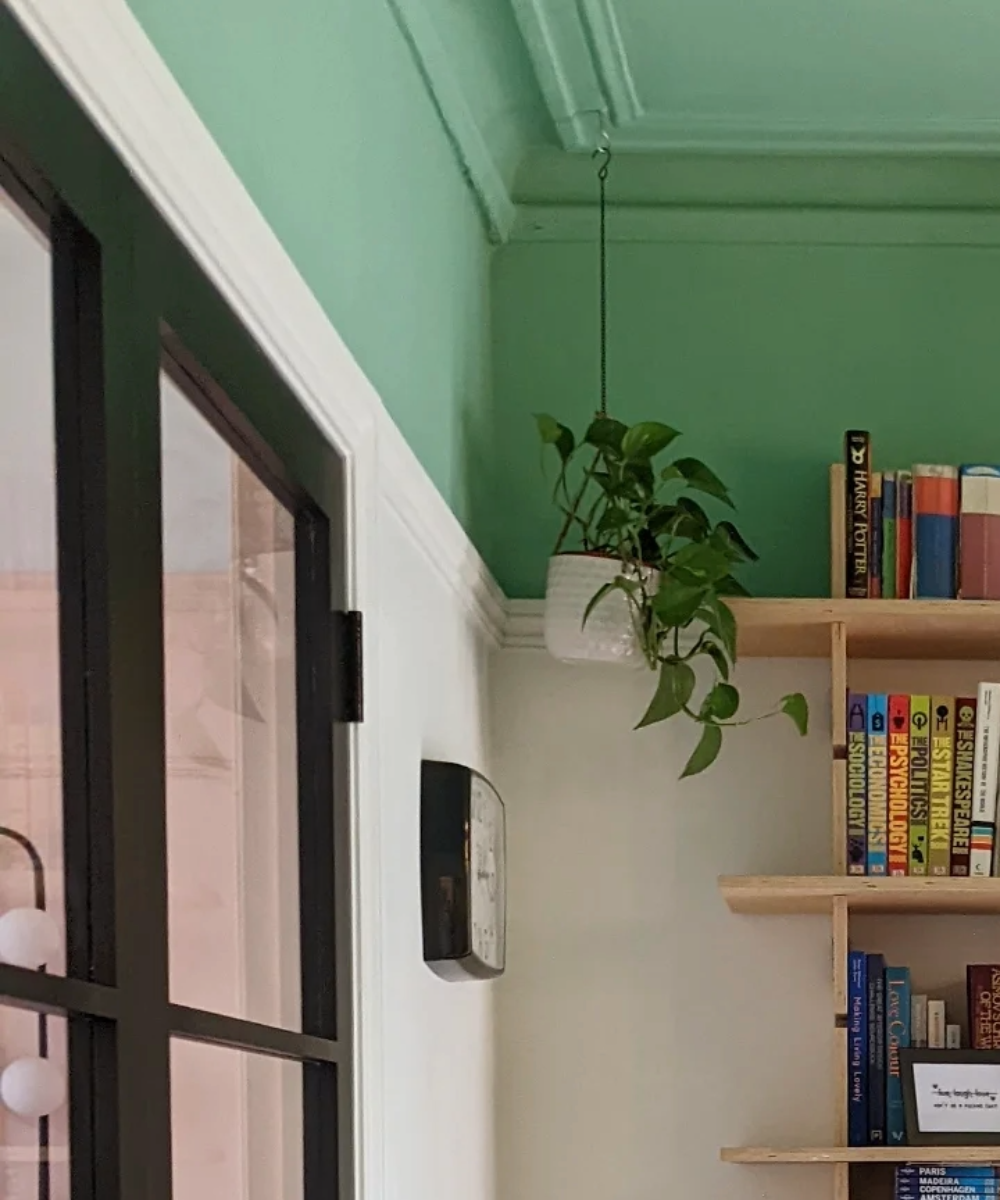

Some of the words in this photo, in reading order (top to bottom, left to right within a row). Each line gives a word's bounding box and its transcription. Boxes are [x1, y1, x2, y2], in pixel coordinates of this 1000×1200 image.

[853, 470, 868, 516] HARRY
[853, 523, 868, 574] POTTER
[848, 743, 866, 826] SOCIOLOGY
[868, 746, 887, 843] ECONOMICS
[911, 747, 929, 818] POLITICS
[932, 749, 951, 795] STAR
[953, 741, 973, 846] SHAKESPEARE
[888, 746, 909, 853] PSYCHOLOGY
[931, 796, 949, 842] TREK
[851, 997, 862, 1033] Making
[887, 980, 905, 1018] Love
[980, 991, 991, 1008] OF
[980, 1010, 991, 1034] THE
[851, 1037, 862, 1066] Living
[852, 1072, 862, 1102] Lovely
[919, 1167, 947, 1176] PARIS
